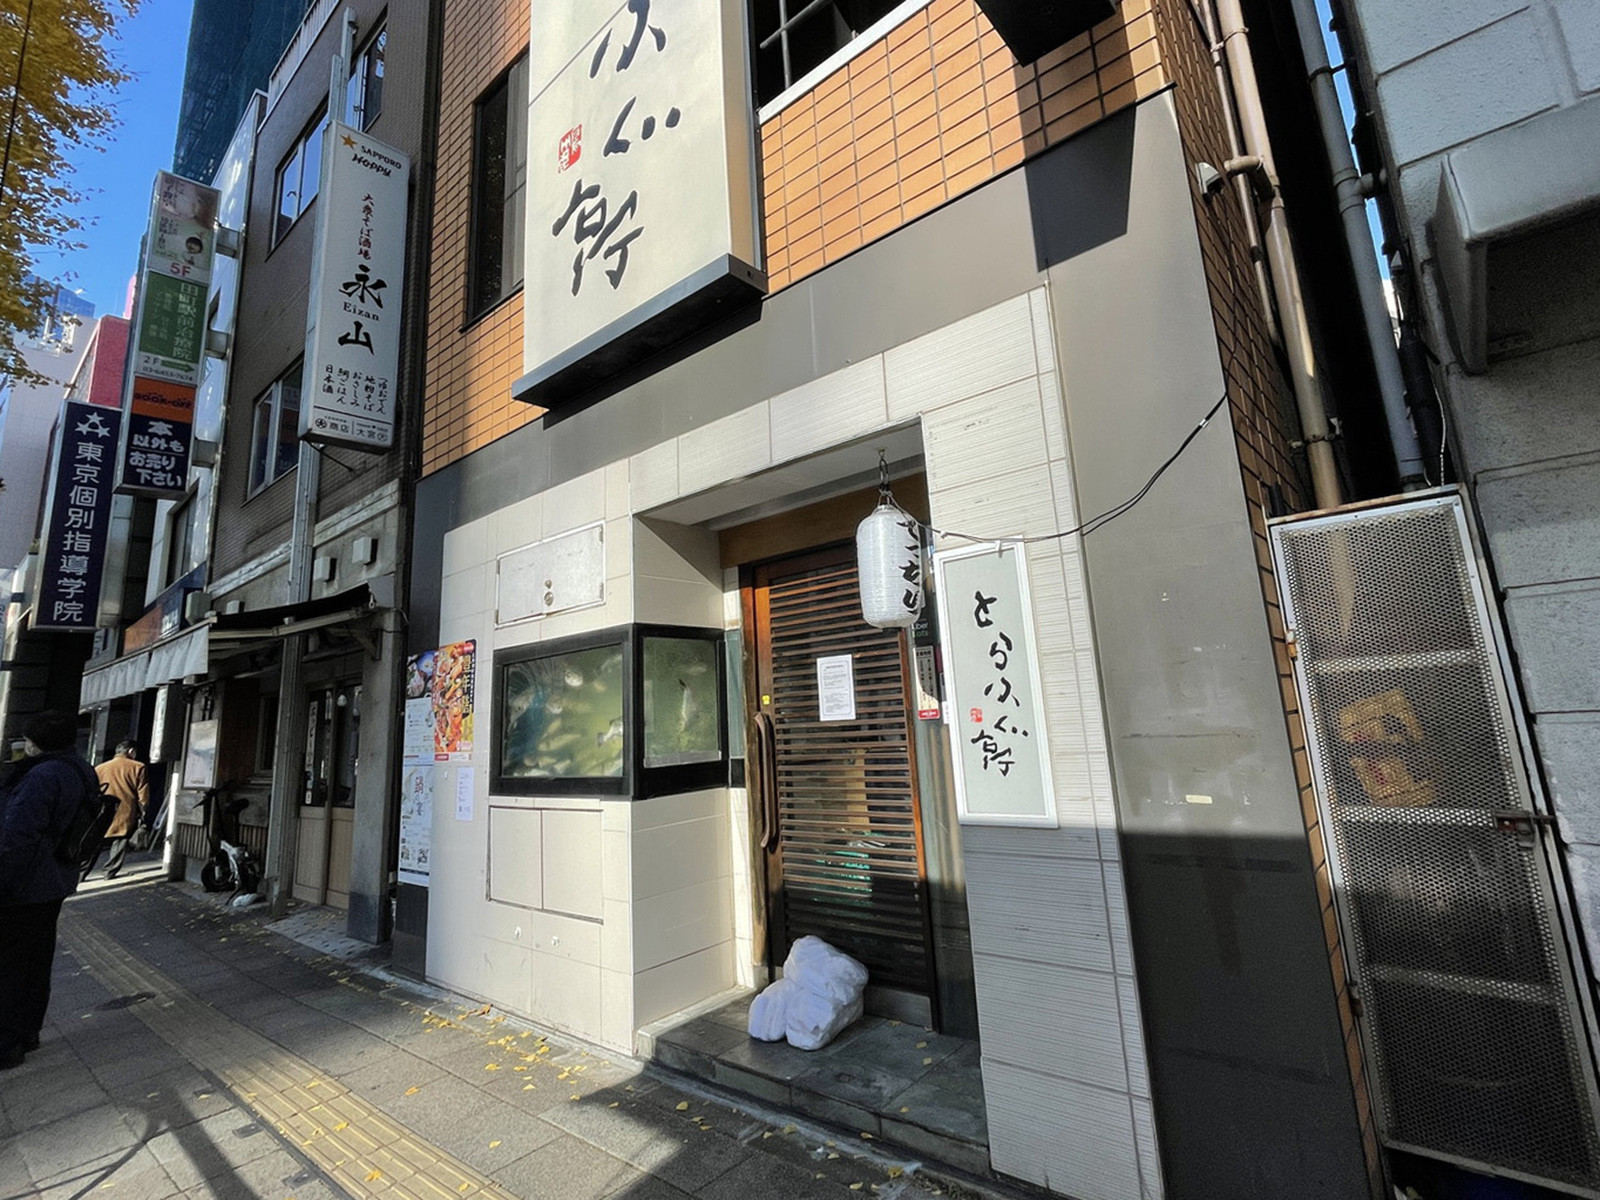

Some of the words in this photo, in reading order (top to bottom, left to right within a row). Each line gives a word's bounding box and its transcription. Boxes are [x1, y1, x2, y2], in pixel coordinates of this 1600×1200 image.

[352, 153, 392, 178] Hoppy
[361, 145, 402, 170] SAPPORO
[358, 192, 375, 261] 大衆そば酒場
[170, 262, 191, 277] 5F
[173, 282, 199, 361] 田町駅前治療院
[343, 301, 380, 322] Eizan
[322, 364, 335, 395] 日本酒
[350, 371, 362, 408] おさしみ
[148, 420, 173, 436] 本
[132, 433, 184, 453] 以外も
[129, 451, 176, 471] お売り
[136, 468, 183, 487] 下さい
[53, 441, 104, 623] 東京個別指導学院
[970, 590, 1029, 777] とらふぐ亭
